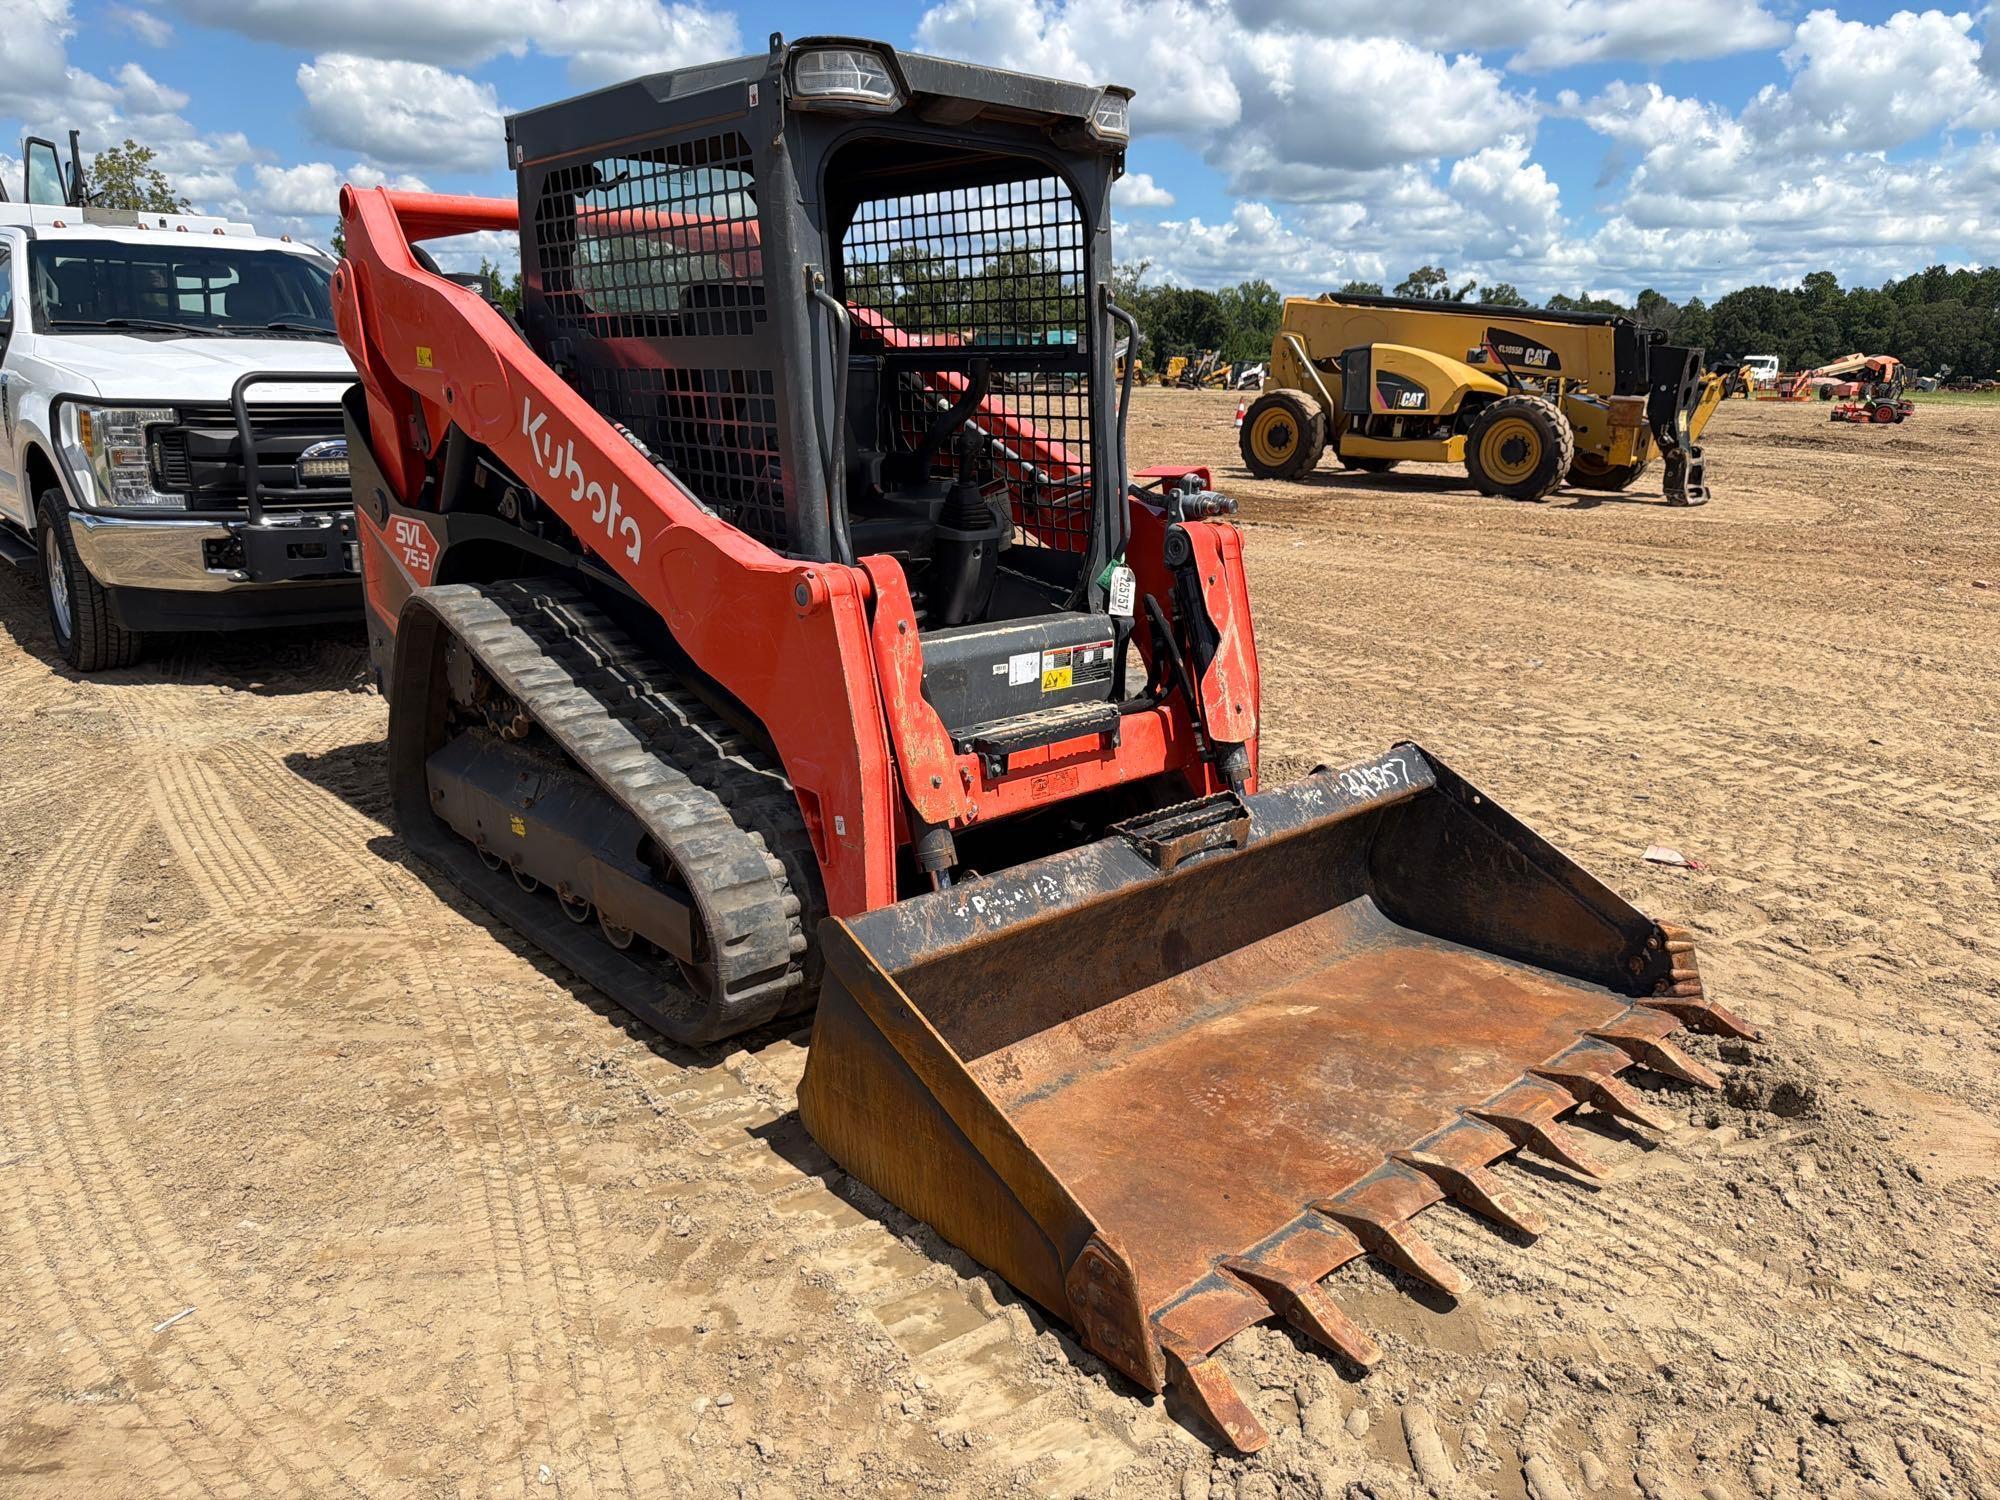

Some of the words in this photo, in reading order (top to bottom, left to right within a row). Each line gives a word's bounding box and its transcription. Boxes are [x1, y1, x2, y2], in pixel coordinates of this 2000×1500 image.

[1524, 347, 1552, 367] CAT
[1400, 391, 1425, 407] CAT
[522, 396, 642, 565] Kubota
[395, 521, 426, 549] SVL
[403, 547, 430, 571] 75-3
[1117, 576, 1131, 610] 225757
